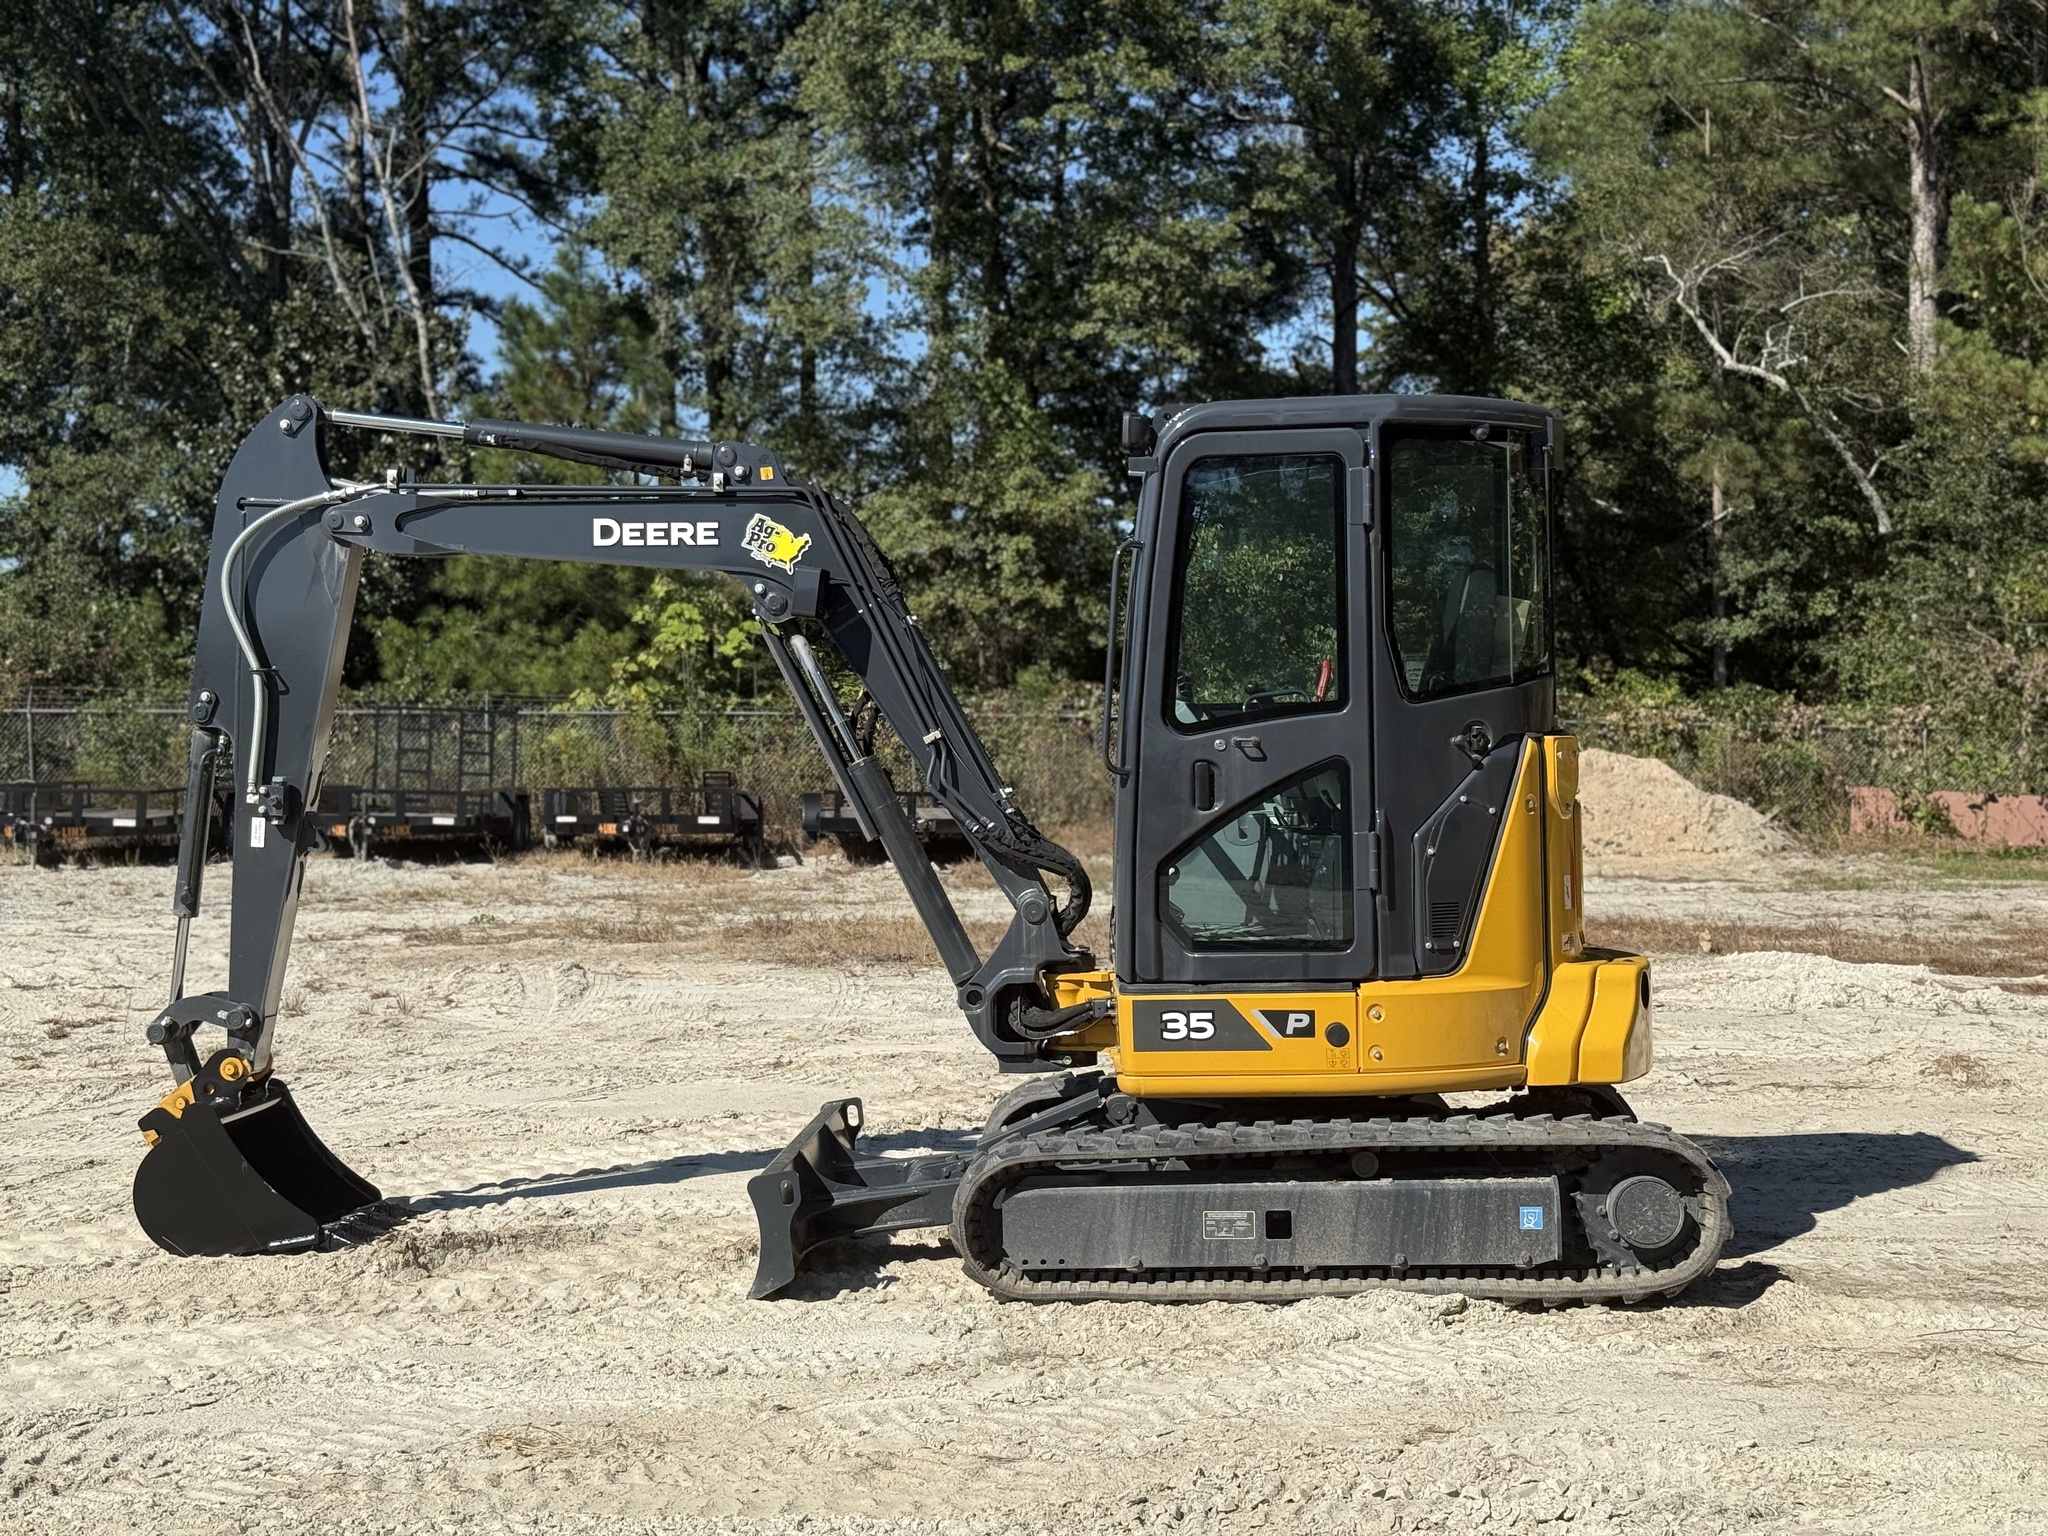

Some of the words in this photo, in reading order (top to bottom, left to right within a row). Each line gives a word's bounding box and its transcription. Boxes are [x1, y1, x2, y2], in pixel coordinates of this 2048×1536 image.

[592, 517, 719, 547] DEERE
[751, 517, 781, 539] Ag-
[746, 531, 776, 553] Pro
[1161, 1012, 1215, 1040] 35
[1285, 1013, 1310, 1035] P
